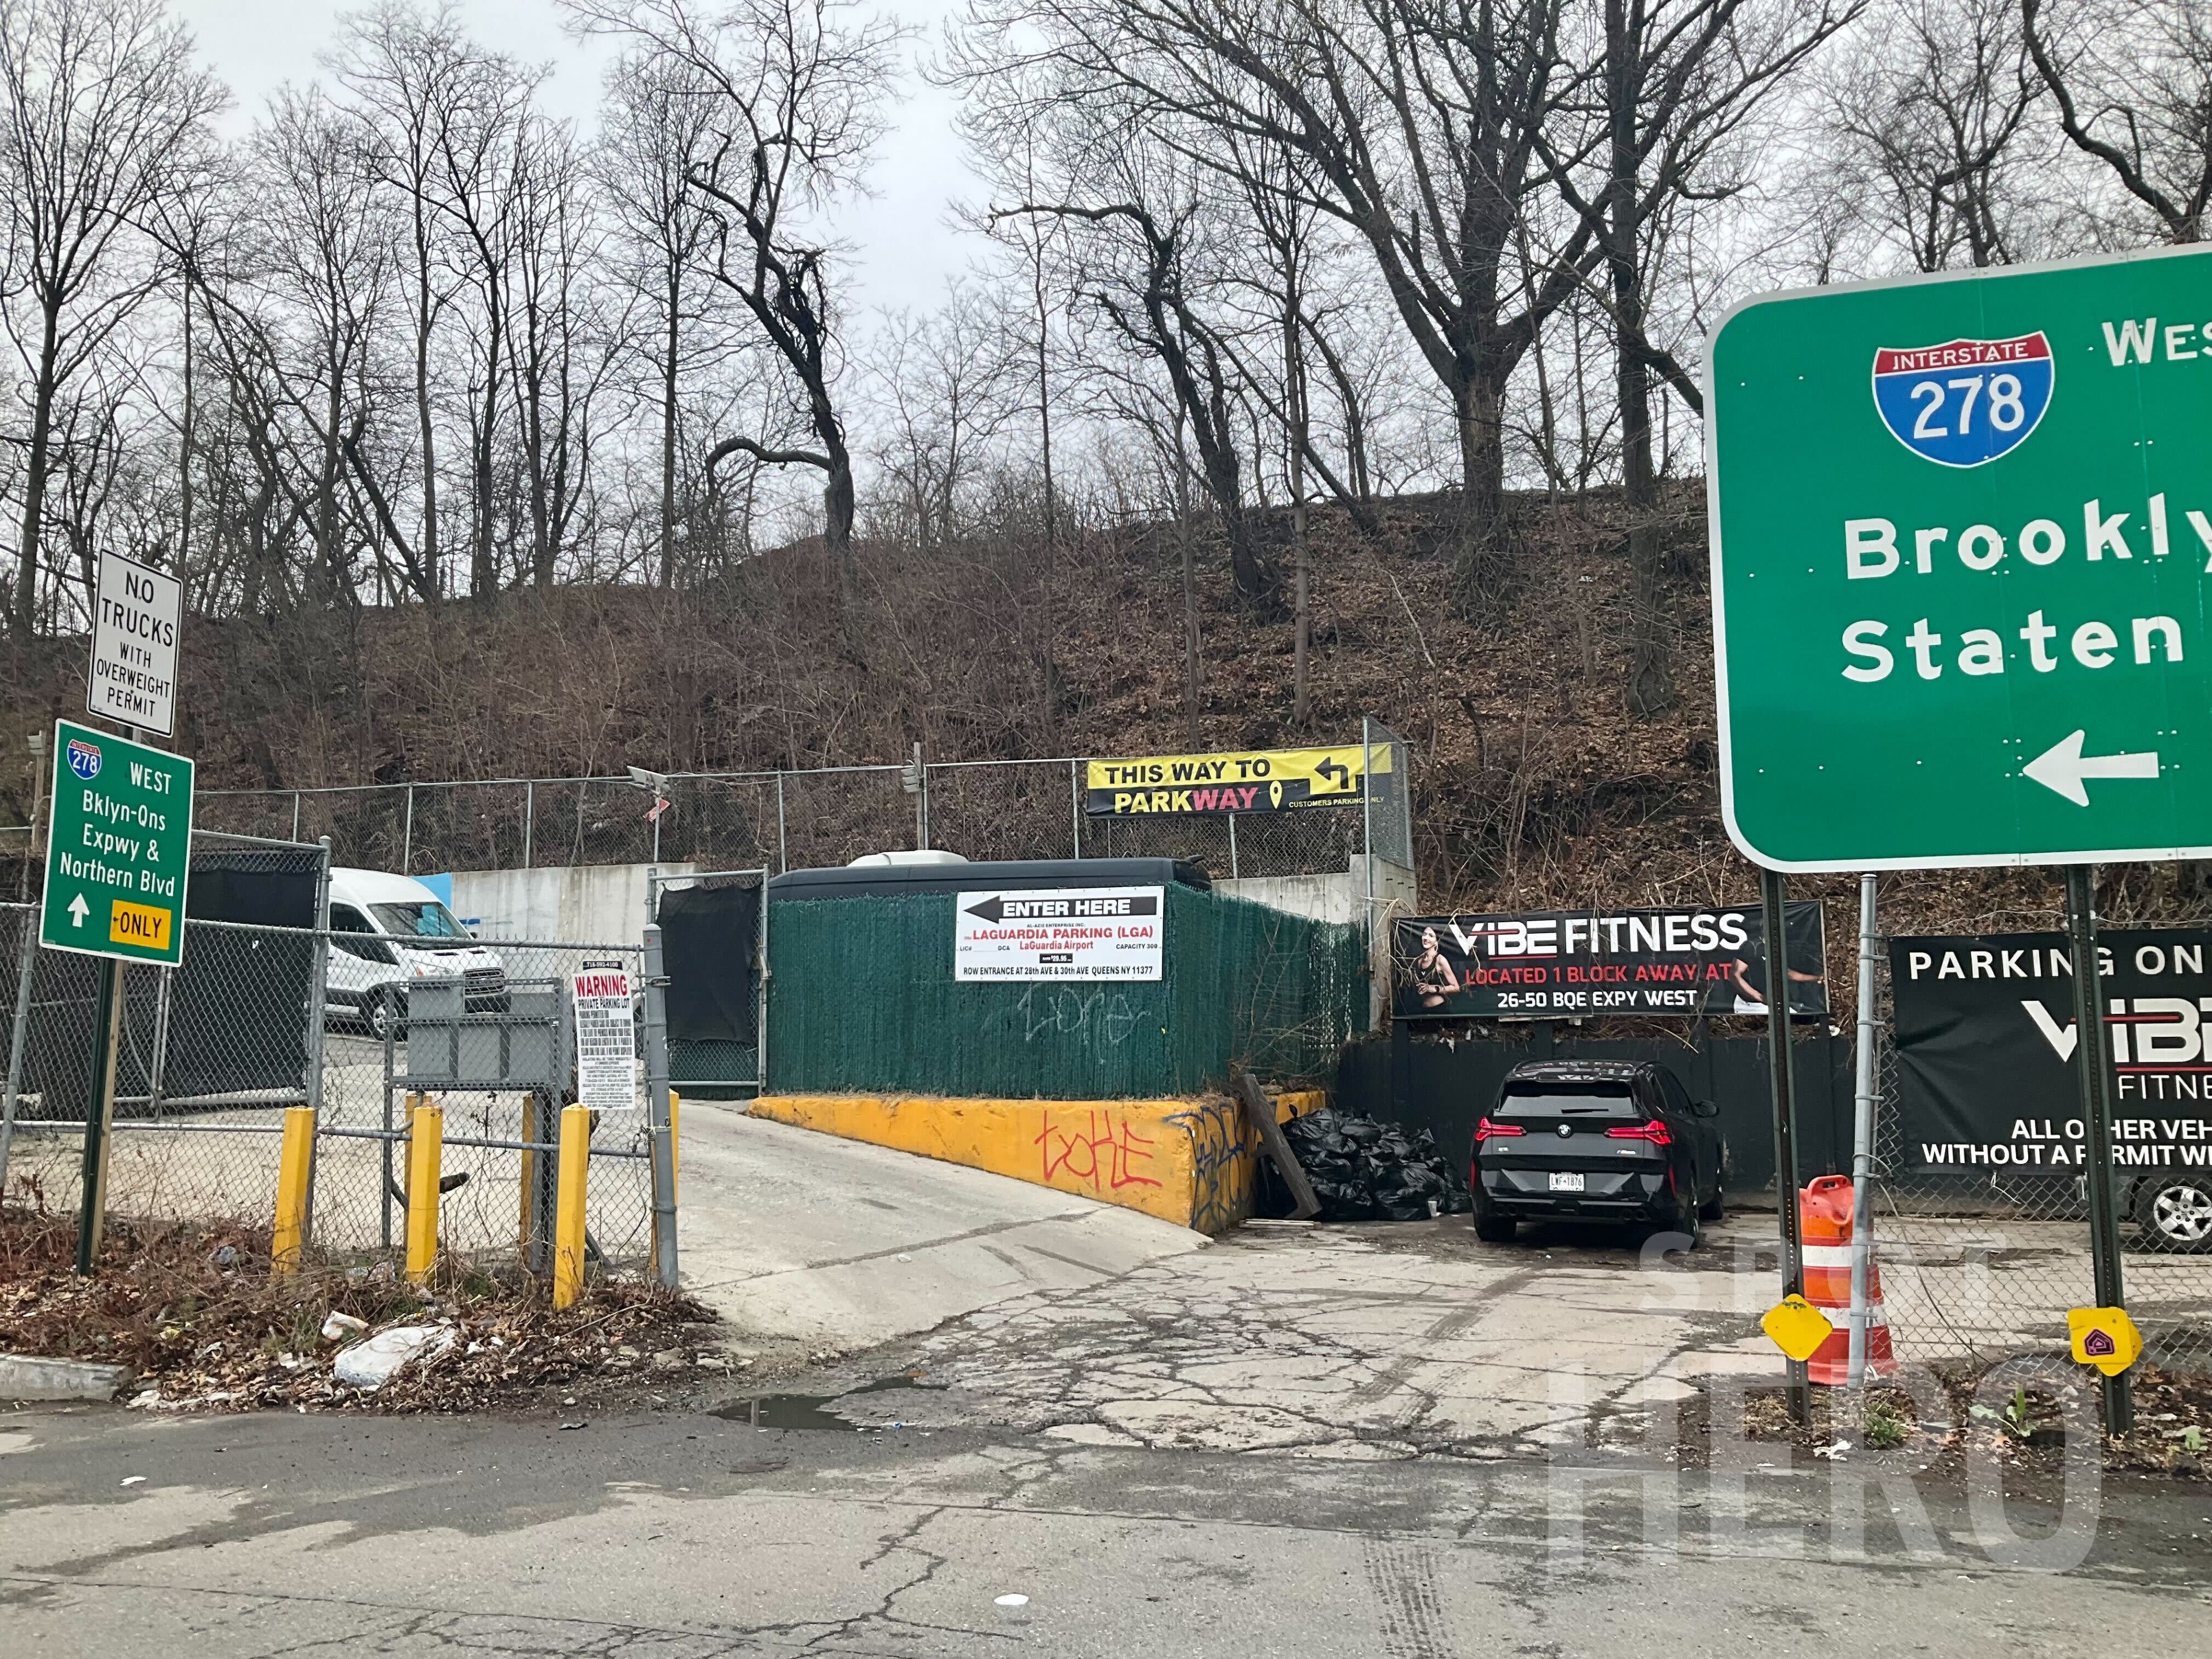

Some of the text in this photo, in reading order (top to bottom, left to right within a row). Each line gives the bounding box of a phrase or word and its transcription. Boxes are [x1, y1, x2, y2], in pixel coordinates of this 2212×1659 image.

[1893, 342, 2028, 370] INTERSTATE
[1911, 374, 2025, 440] 278
[125, 571, 154, 604] NO
[102, 597, 173, 647] TRUCKS
[120, 642, 151, 668] WITH
[1841, 609, 2183, 682] Staten
[97, 658, 170, 698] OVERWEIGHT
[107, 687, 155, 717] PERMIT
[71, 741, 98, 754] INTERSTATE
[73, 751, 97, 774] 278
[1105, 759, 1271, 784] THIS WAY TO
[130, 762, 172, 794] WEST
[83, 789, 165, 831] Bklyn-Qns
[1115, 787, 1259, 813] PARKWAY
[1289, 799, 1332, 808] CUSTOMERS
[83, 823, 160, 862] Expwy &
[60, 851, 175, 897] Northern Blvd
[1003, 899, 1130, 917] ENTER HERE
[120, 911, 162, 938] ONLY
[973, 929, 1048, 940] LAGUARDIA
[1053, 927, 1112, 939] PARKING
[1118, 925, 1153, 938] (LGA)
[1565, 913, 1748, 954] FITNESS
[1020, 940, 1093, 951] LaGuardia Airport
[1025, 967, 1039, 975] 28th
[1060, 967, 1074, 975] 30th
[1092, 966, 1119, 976] QUEENS
[1121, 966, 1130, 974] NY
[1132, 966, 1153, 974] 11377
[1465, 963, 1732, 984] LOCATED 1 BLOCK AWAY AT
[1910, 945, 2203, 979] PARKING ON
[575, 974, 627, 997] WARNING
[578, 997, 630, 1009] PRIVATE PARKING LOT
[1498, 990, 1697, 1009] 26-50 BQE EXPY WEST
[2012, 1119, 2061, 1139] ALL
[2065, 1119, 2157, 1139] OHER
[1922, 1143, 2046, 1164] WITHOUT
[2051, 1145, 2071, 1165] A
[2075, 1145, 2175, 1165] PRMIT
[1567, 1177, 1582, 1186] 1876
